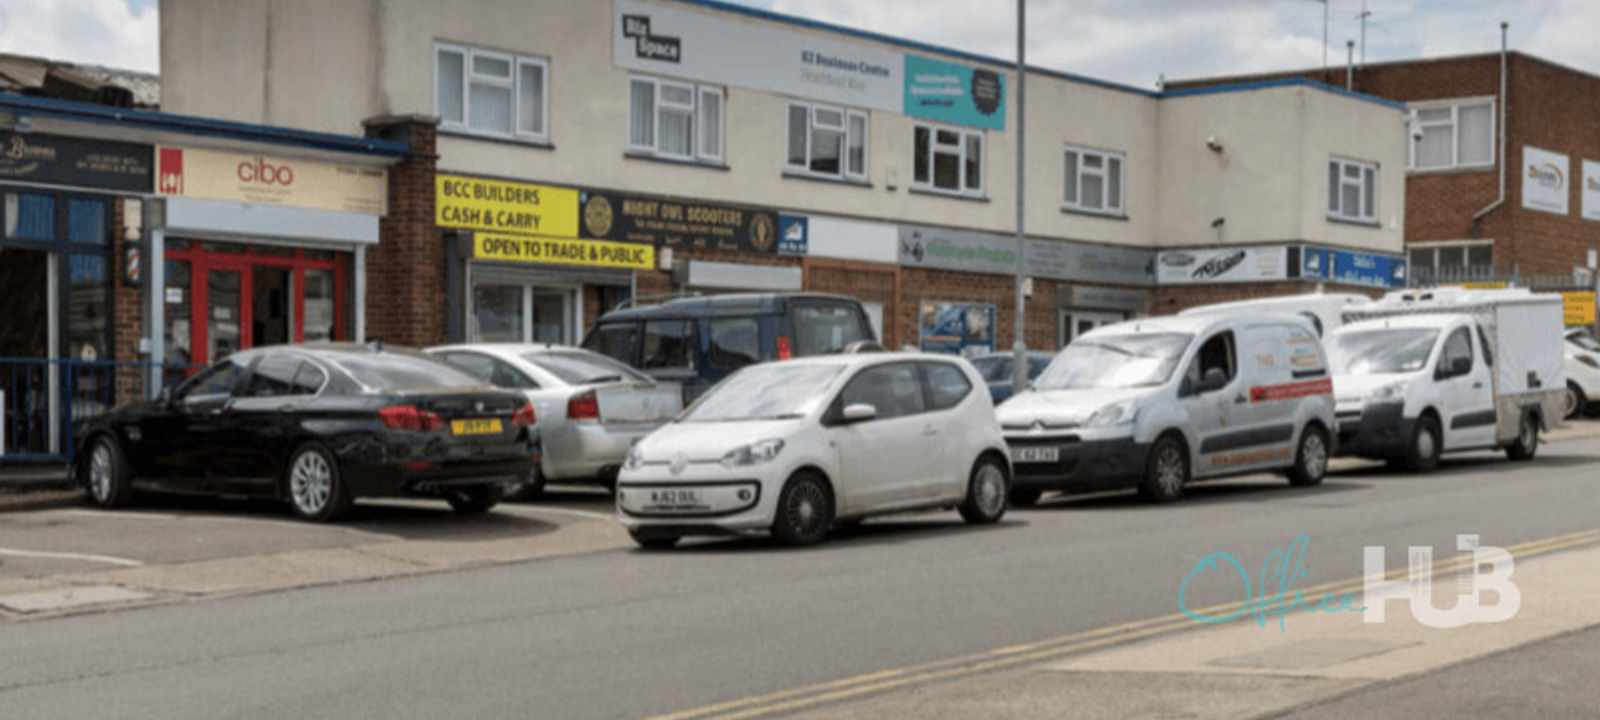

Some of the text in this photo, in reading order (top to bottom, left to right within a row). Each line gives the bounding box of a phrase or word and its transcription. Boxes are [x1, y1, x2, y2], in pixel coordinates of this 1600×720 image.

[639, 37, 677, 58] Space
[816, 52, 858, 72] Business
[859, 61, 889, 78] Centre
[237, 156, 294, 186] cibo
[443, 180, 540, 205] BCC BUILDERS
[441, 206, 542, 231] CASH & CARRY
[622, 199, 743, 226] NIGHT OWL SCOOTERS
[482, 237, 645, 264] OPEN TO TRADE & PUBLIC
